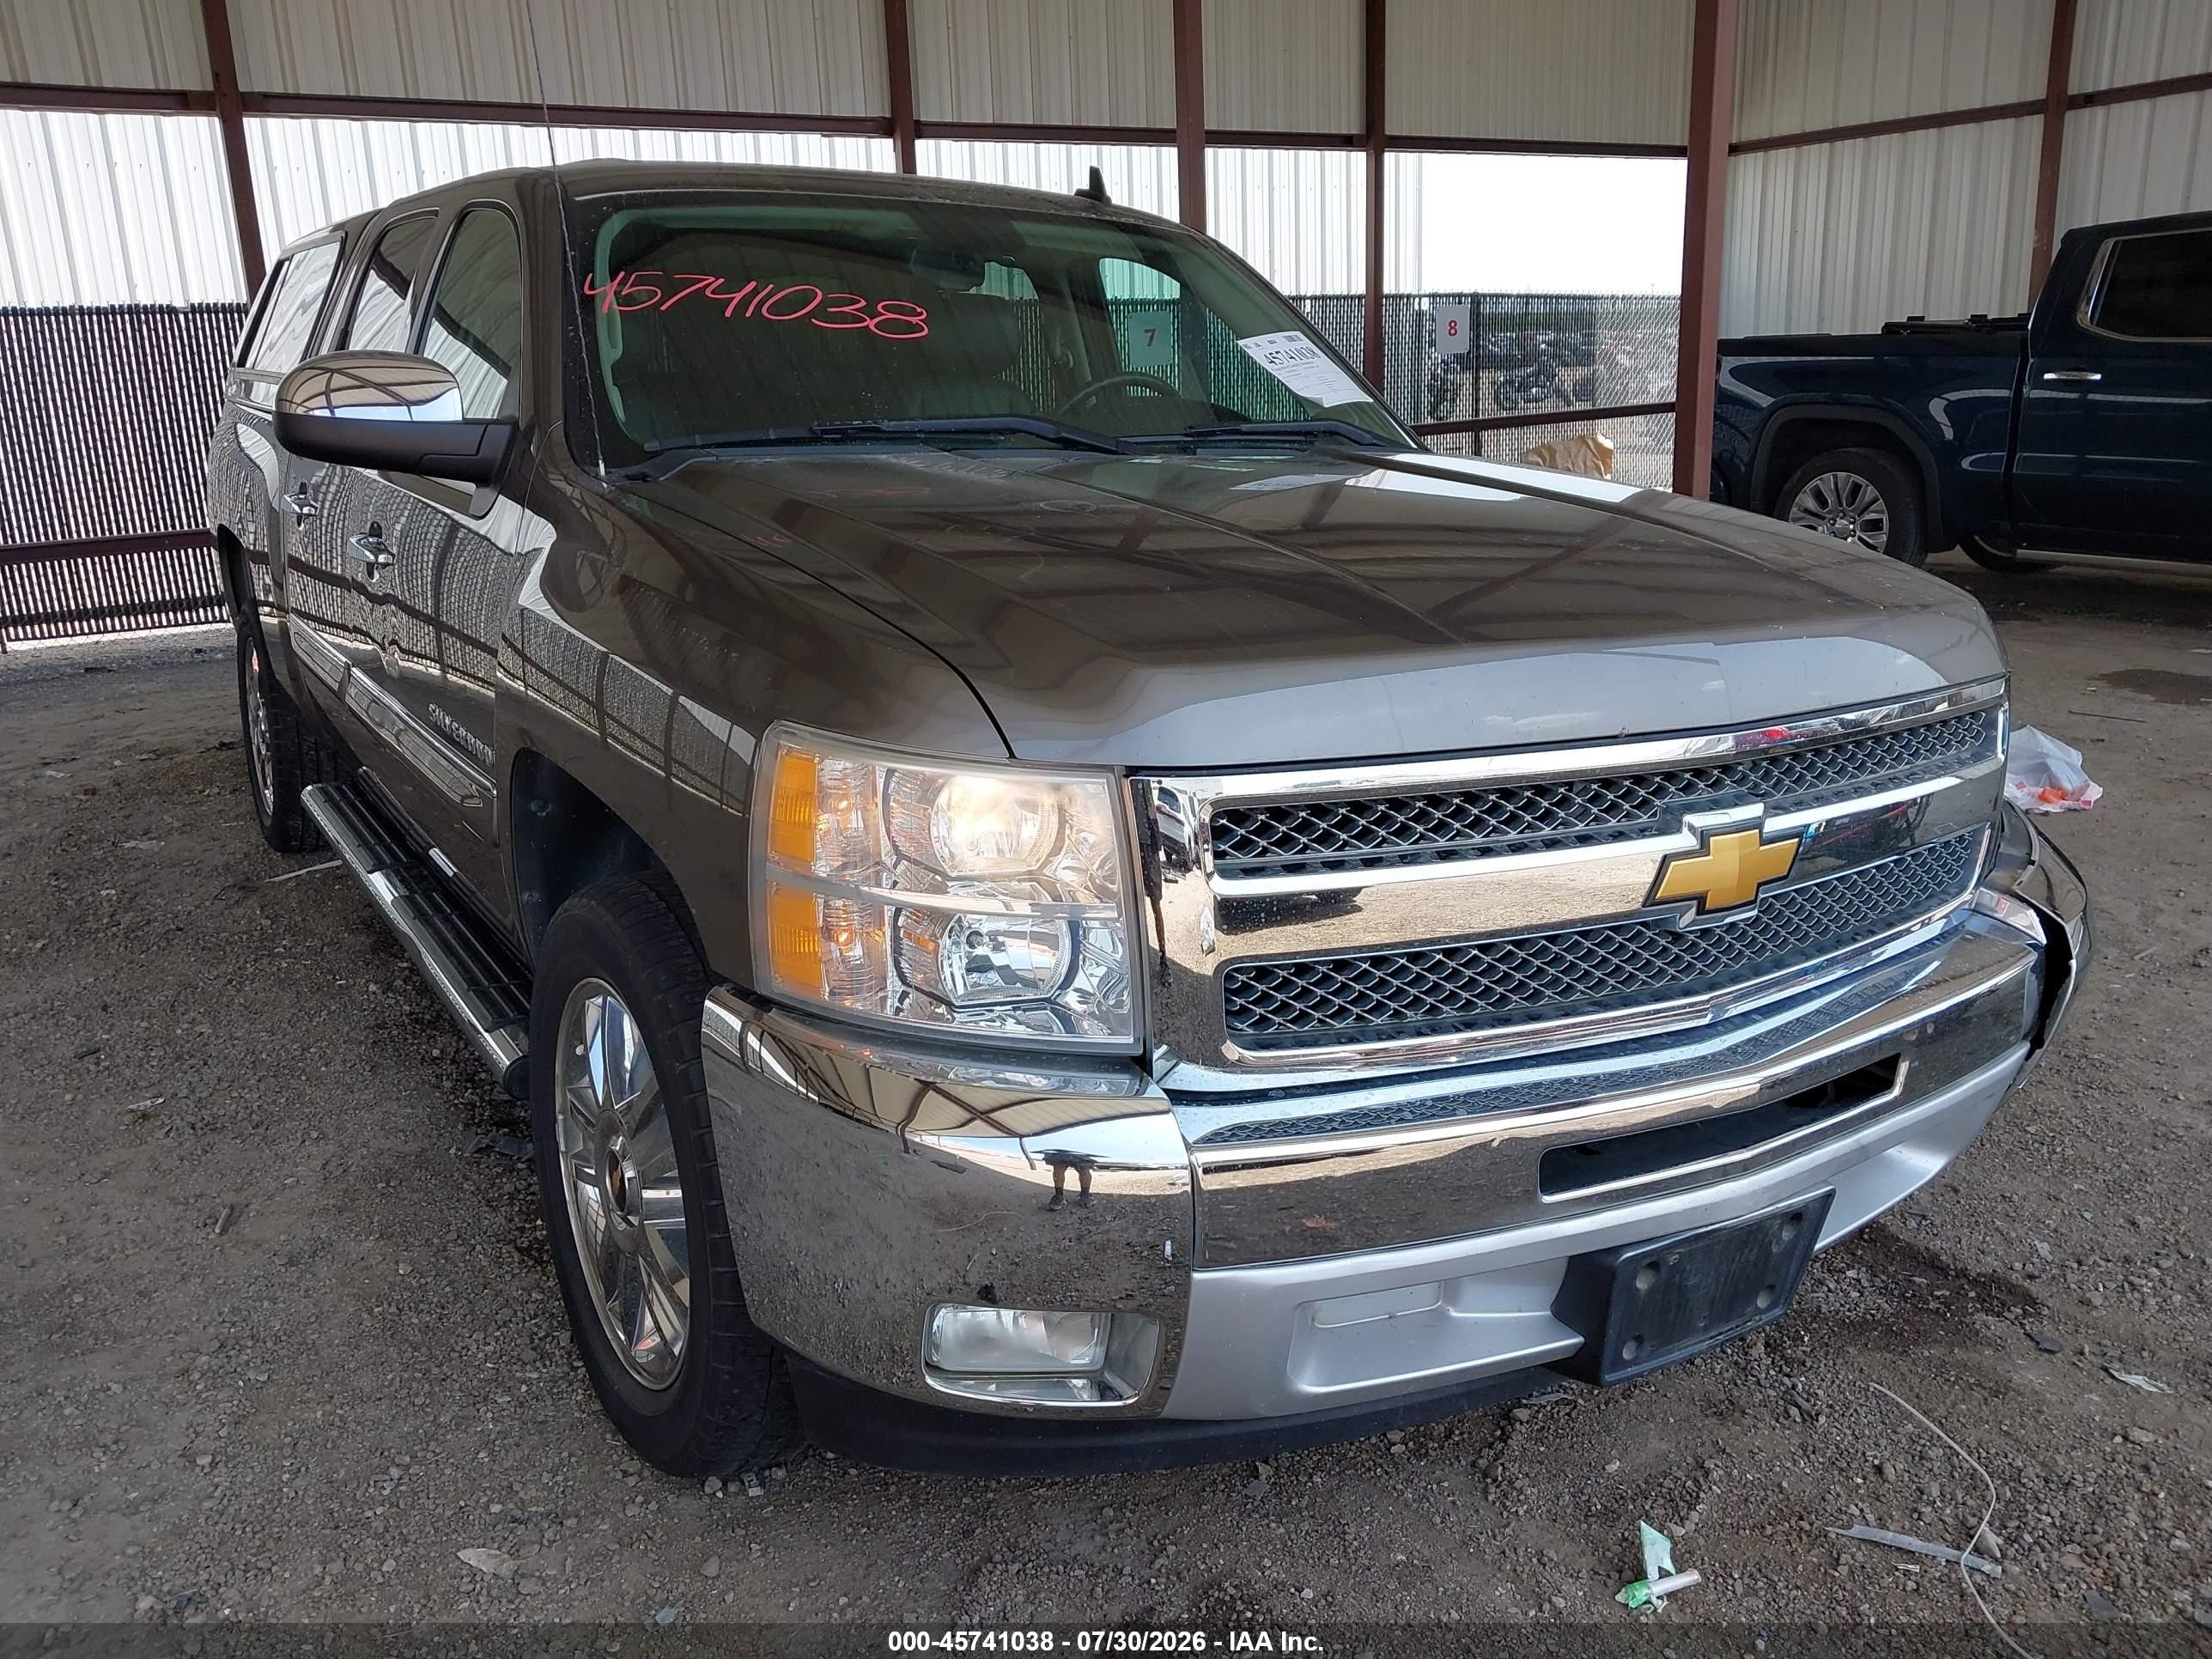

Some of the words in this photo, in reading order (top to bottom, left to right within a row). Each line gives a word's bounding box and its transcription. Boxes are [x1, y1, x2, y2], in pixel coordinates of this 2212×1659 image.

[583, 270, 929, 339] 45741038
[1144, 328, 1156, 347] 7
[1448, 319, 1458, 337] 8
[1263, 345, 1322, 366] 45741038
[428, 702, 496, 767] SILVERADO
